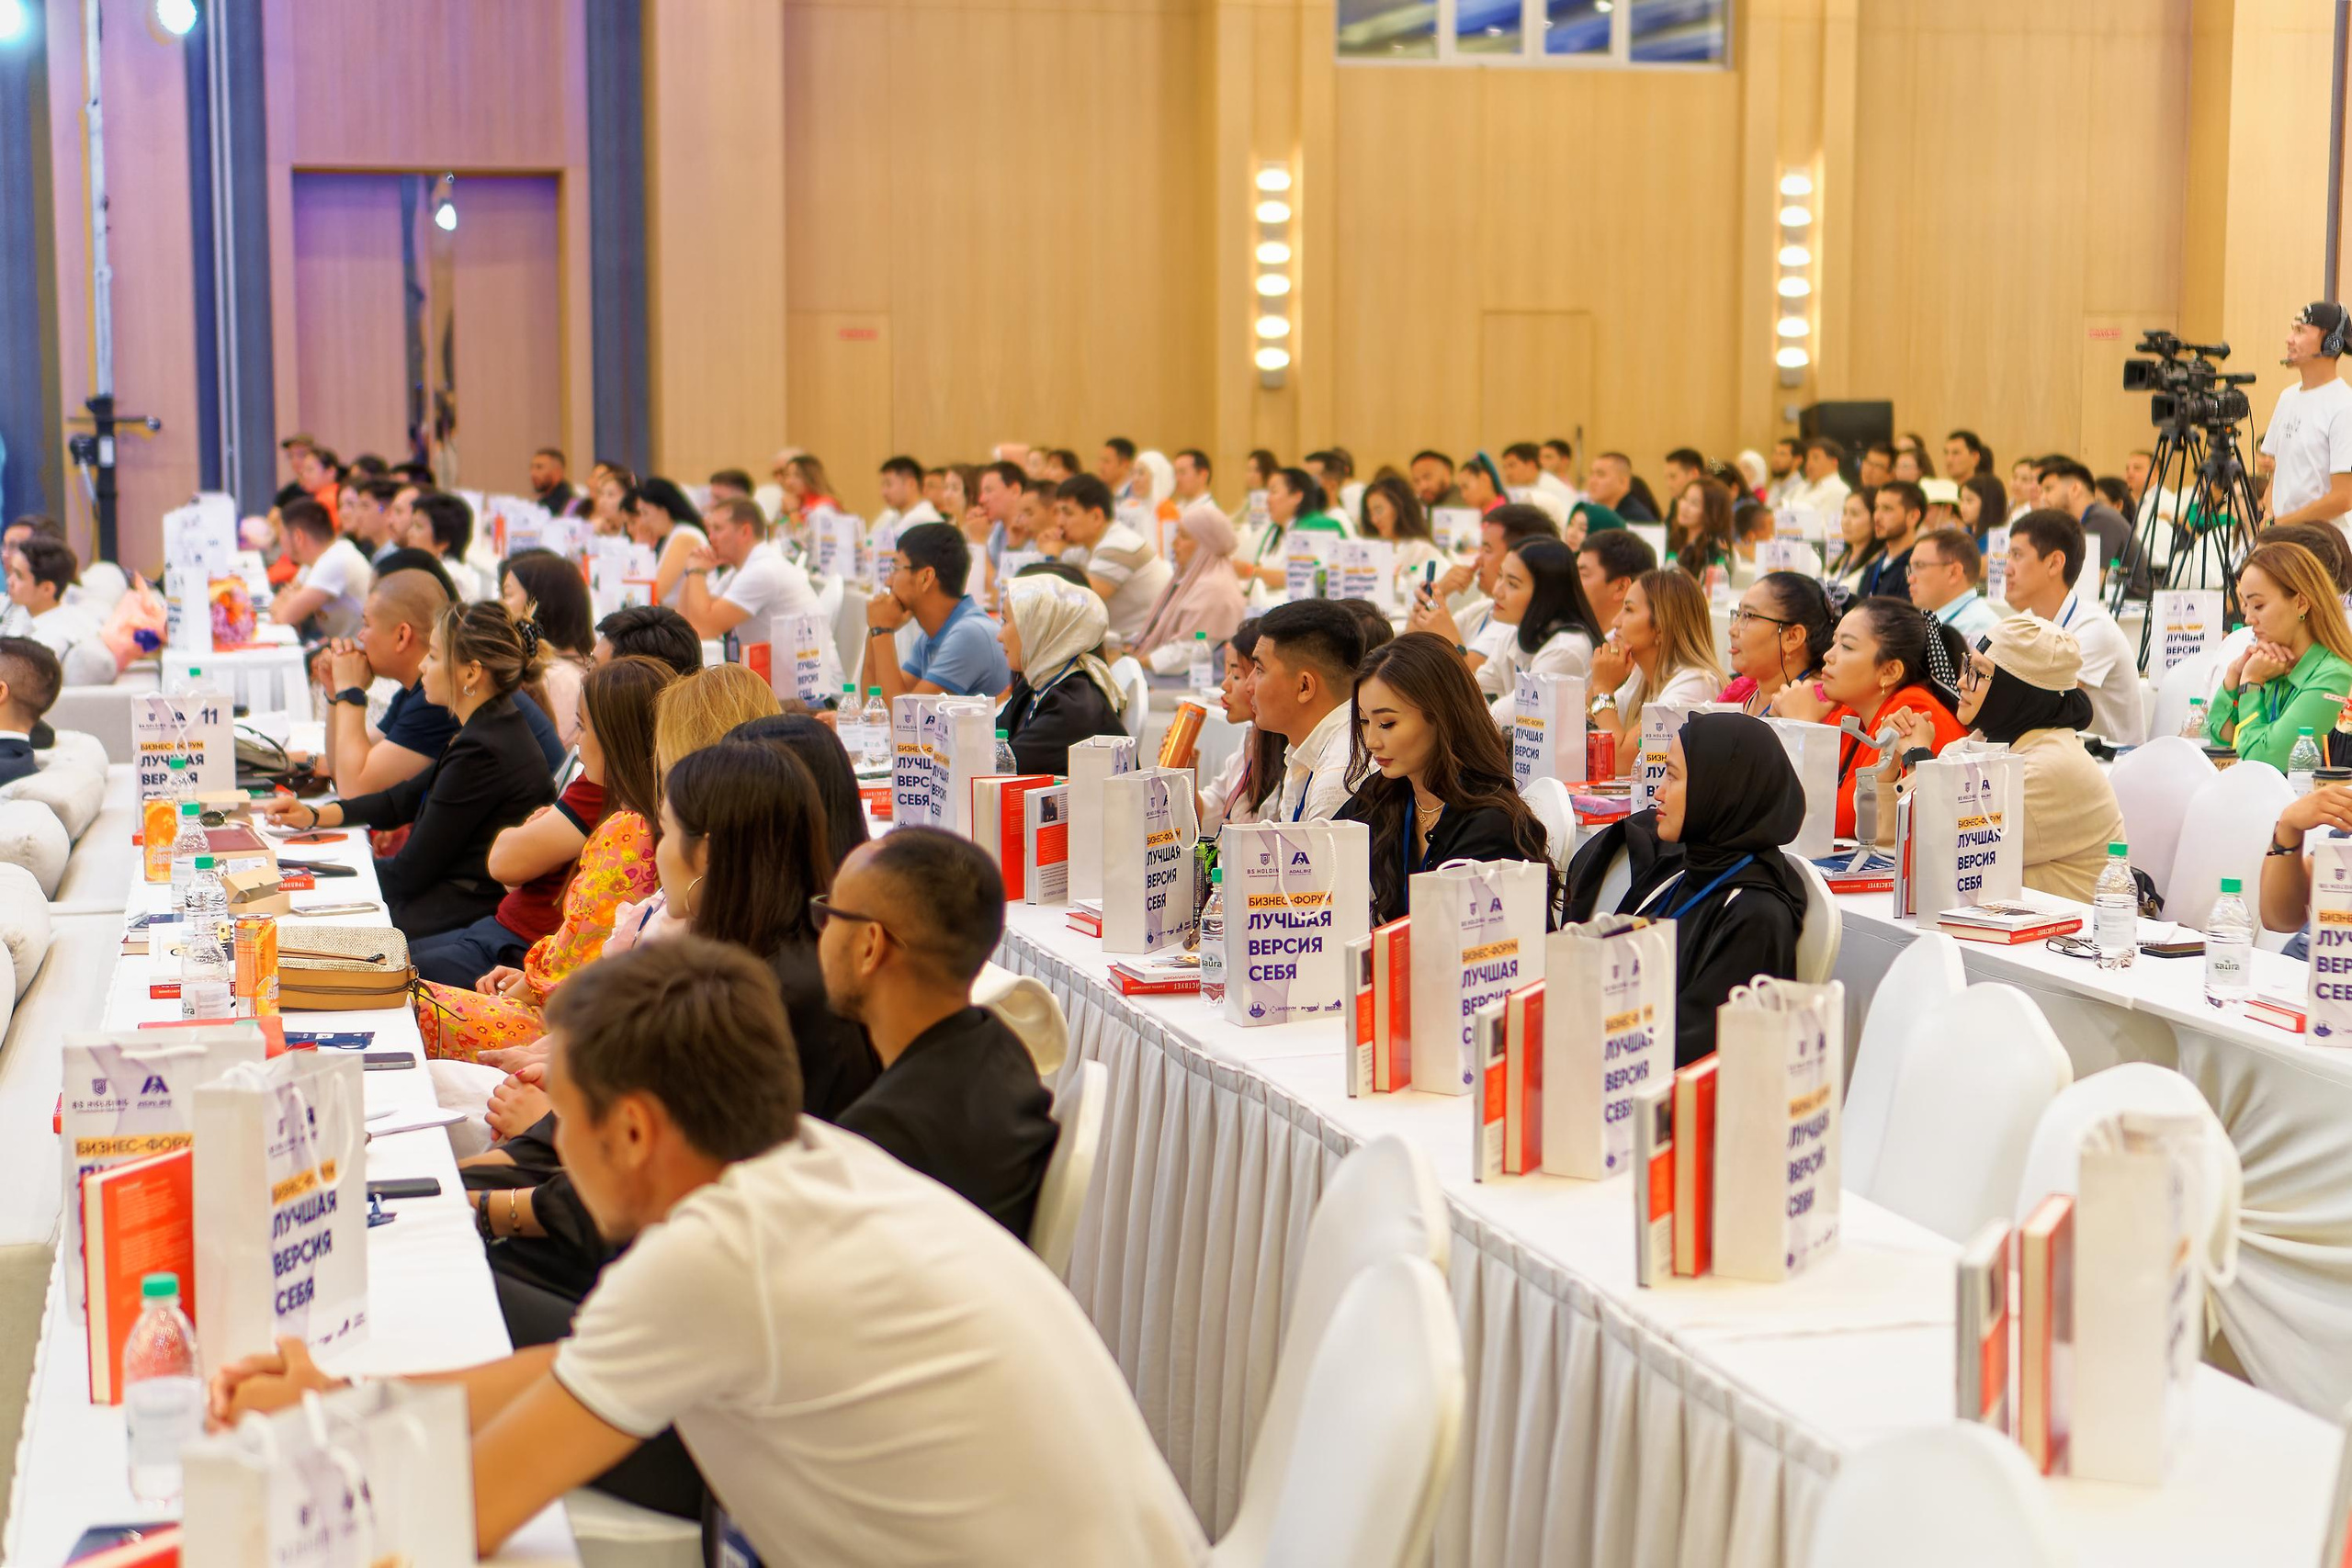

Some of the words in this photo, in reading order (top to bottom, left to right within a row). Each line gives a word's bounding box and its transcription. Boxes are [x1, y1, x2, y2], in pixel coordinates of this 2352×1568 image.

[201, 707, 218, 725] 11
[1515, 728, 1544, 743] ЛУЧШАЯ
[141, 753, 204, 767] ЛУЧАЯ
[1515, 745, 1540, 760] ВЕРСИЯ
[898, 757, 932, 769] ЛУЧШ
[1515, 762, 1531, 775] СЕБЯ
[141, 772, 198, 785] ВЕРЯ
[898, 775, 932, 788] ВЕРС
[898, 794, 931, 807] СЕБЯ
[1147, 845, 1181, 866] ЛУЧШАЯ
[1958, 851, 1996, 871] ВЕРСИЯ
[1147, 867, 1177, 889] ВЕРСИЯ
[1957, 874, 1983, 893] СЕБЯ
[1147, 893, 1167, 912] СЕБЯ
[1248, 910, 1332, 931] ЛУЧШАЯ
[1249, 936, 1323, 956] ВЕРСИЯ
[1249, 963, 1297, 982] СЕБЯ
[1462, 959, 1518, 988] ЛУЧШАЯ
[2316, 955, 2352, 974] ВЕР
[272, 1189, 337, 1239] ЛУЧШАЯ
[273, 1228, 333, 1278] ВЕРСИЯ
[275, 1276, 315, 1316] СЕБЯ
